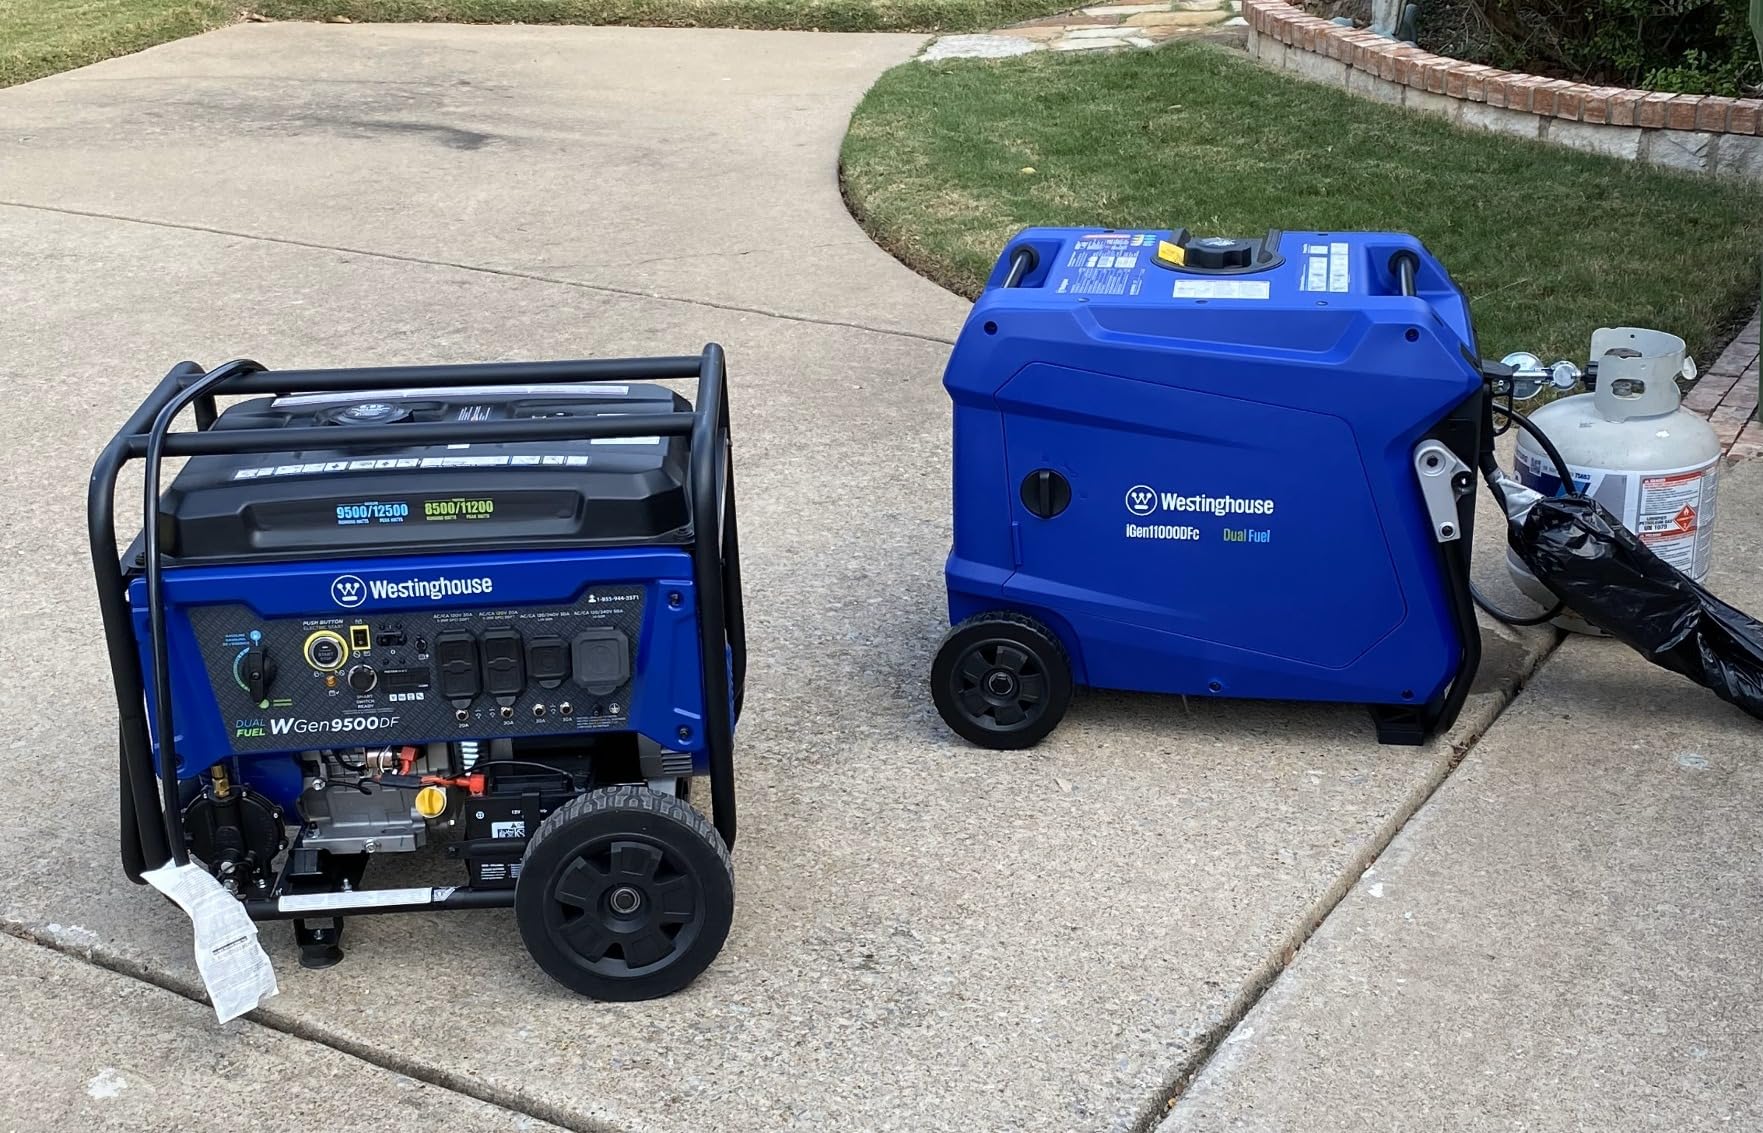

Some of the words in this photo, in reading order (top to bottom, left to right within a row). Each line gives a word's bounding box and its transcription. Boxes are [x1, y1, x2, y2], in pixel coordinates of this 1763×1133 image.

[336, 503, 409, 519] 9500/12500
[424, 500, 494, 515] 8500/11200
[1160, 492, 1275, 516] Westinghouse
[1126, 523, 1200, 541] iGen11000DFc
[1223, 528, 1247, 542] Dual
[1248, 529, 1271, 543] Fuel
[369, 577, 493, 600] Westinghouse
[235, 719, 266, 728] DUAL
[236, 727, 266, 738] FUEL
